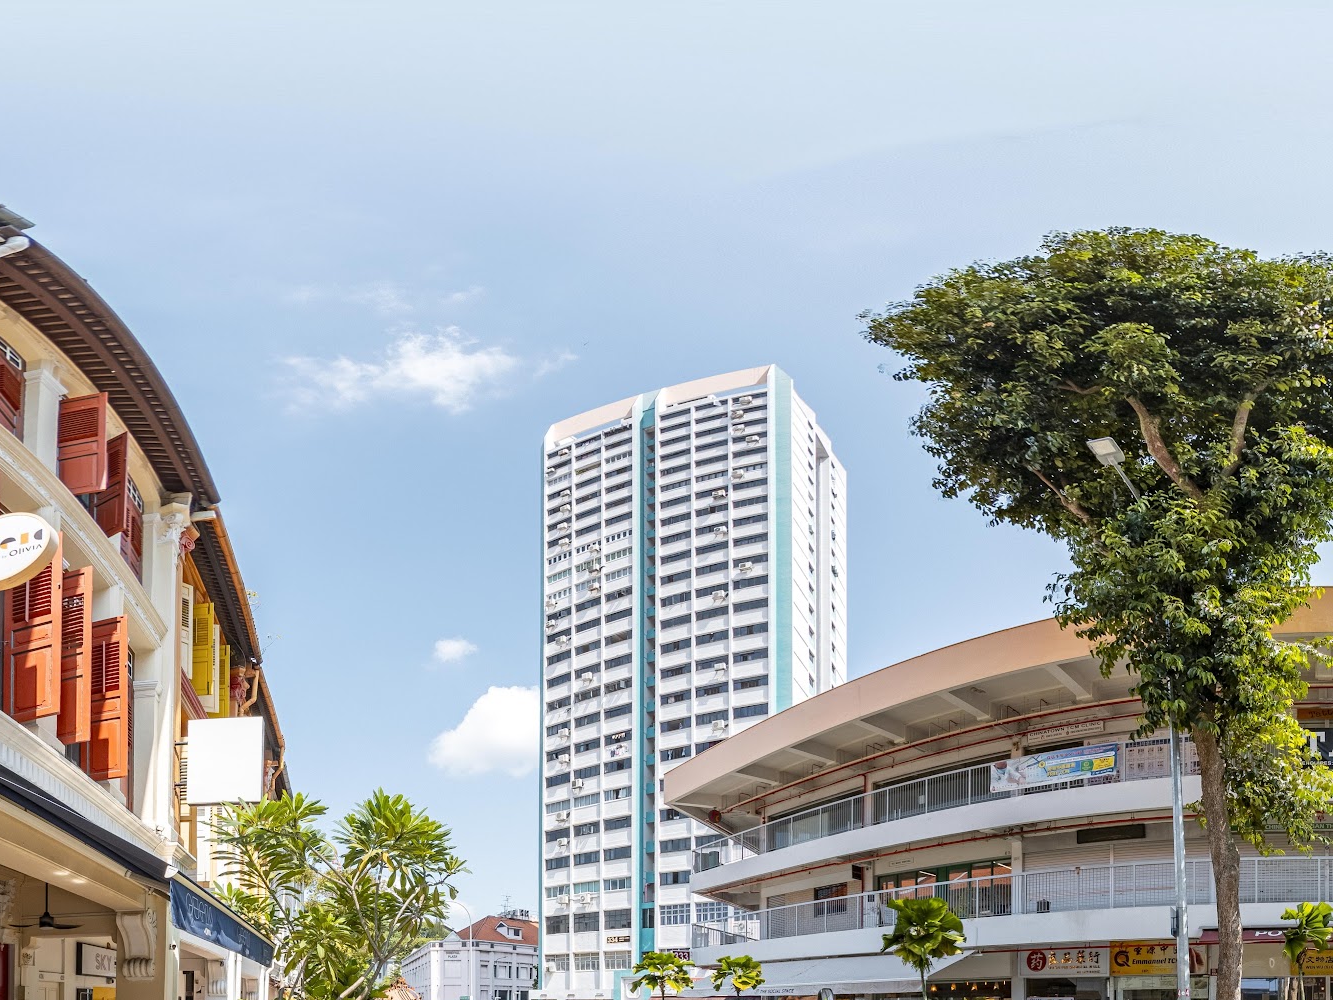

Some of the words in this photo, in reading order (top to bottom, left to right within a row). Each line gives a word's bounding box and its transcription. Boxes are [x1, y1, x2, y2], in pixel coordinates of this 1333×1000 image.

[1029, 727, 1065, 737] CHINATOWN
[95, 953, 113, 972] SKY
[1030, 954, 1043, 969] 药
[1132, 957, 1167, 965] Emmanuel
